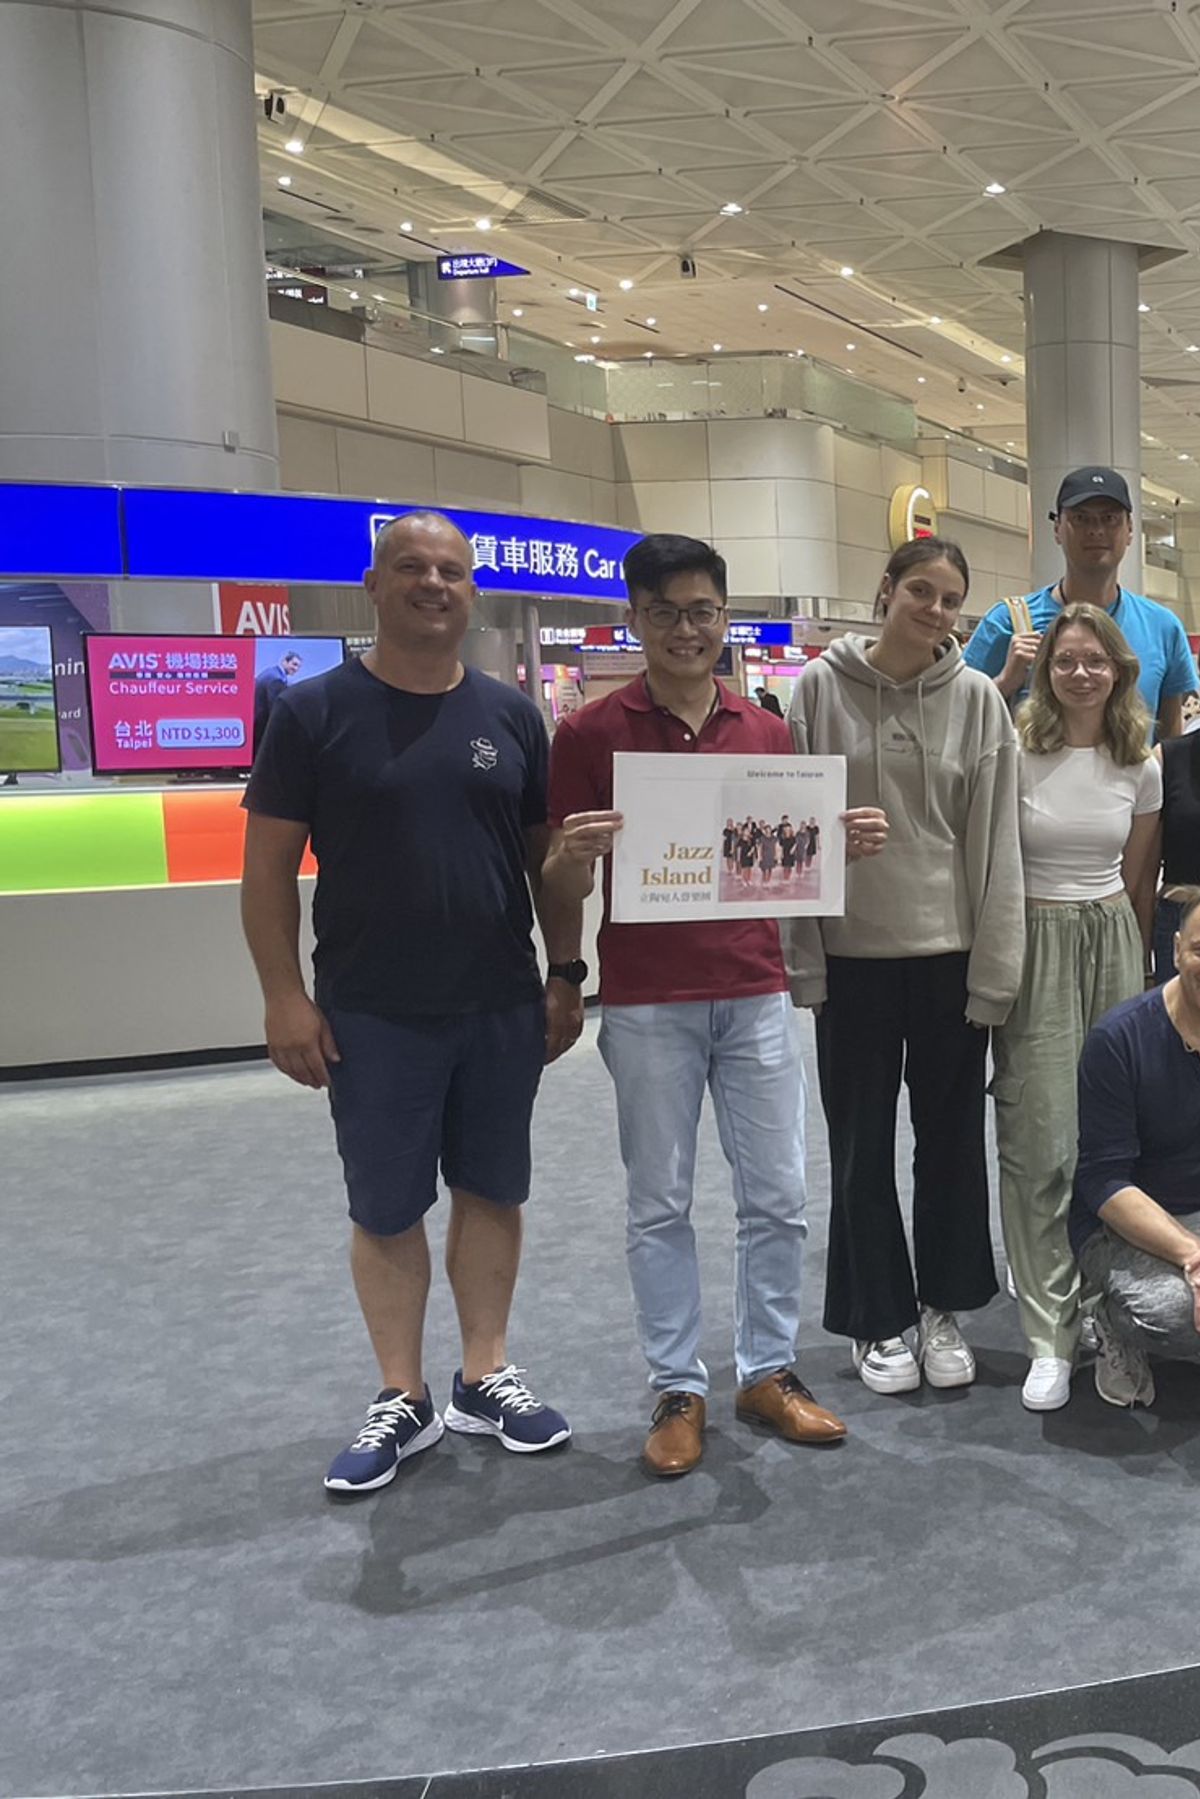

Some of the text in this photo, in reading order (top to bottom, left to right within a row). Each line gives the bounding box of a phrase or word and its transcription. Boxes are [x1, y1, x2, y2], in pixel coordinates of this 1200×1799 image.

[470, 533, 579, 578] 賃車服務
[584, 548, 616, 579] Car
[235, 600, 291, 636] AVIS
[108, 652, 239, 670] AVIS 機場接送
[109, 681, 239, 695] Chauffeur Service
[58, 707, 81, 720] ard
[114, 720, 153, 737] 台北
[161, 726, 241, 743] NTD $1,300
[116, 738, 153, 750] Taipei
[663, 842, 714, 861] Jazz
[641, 865, 712, 886] Island
